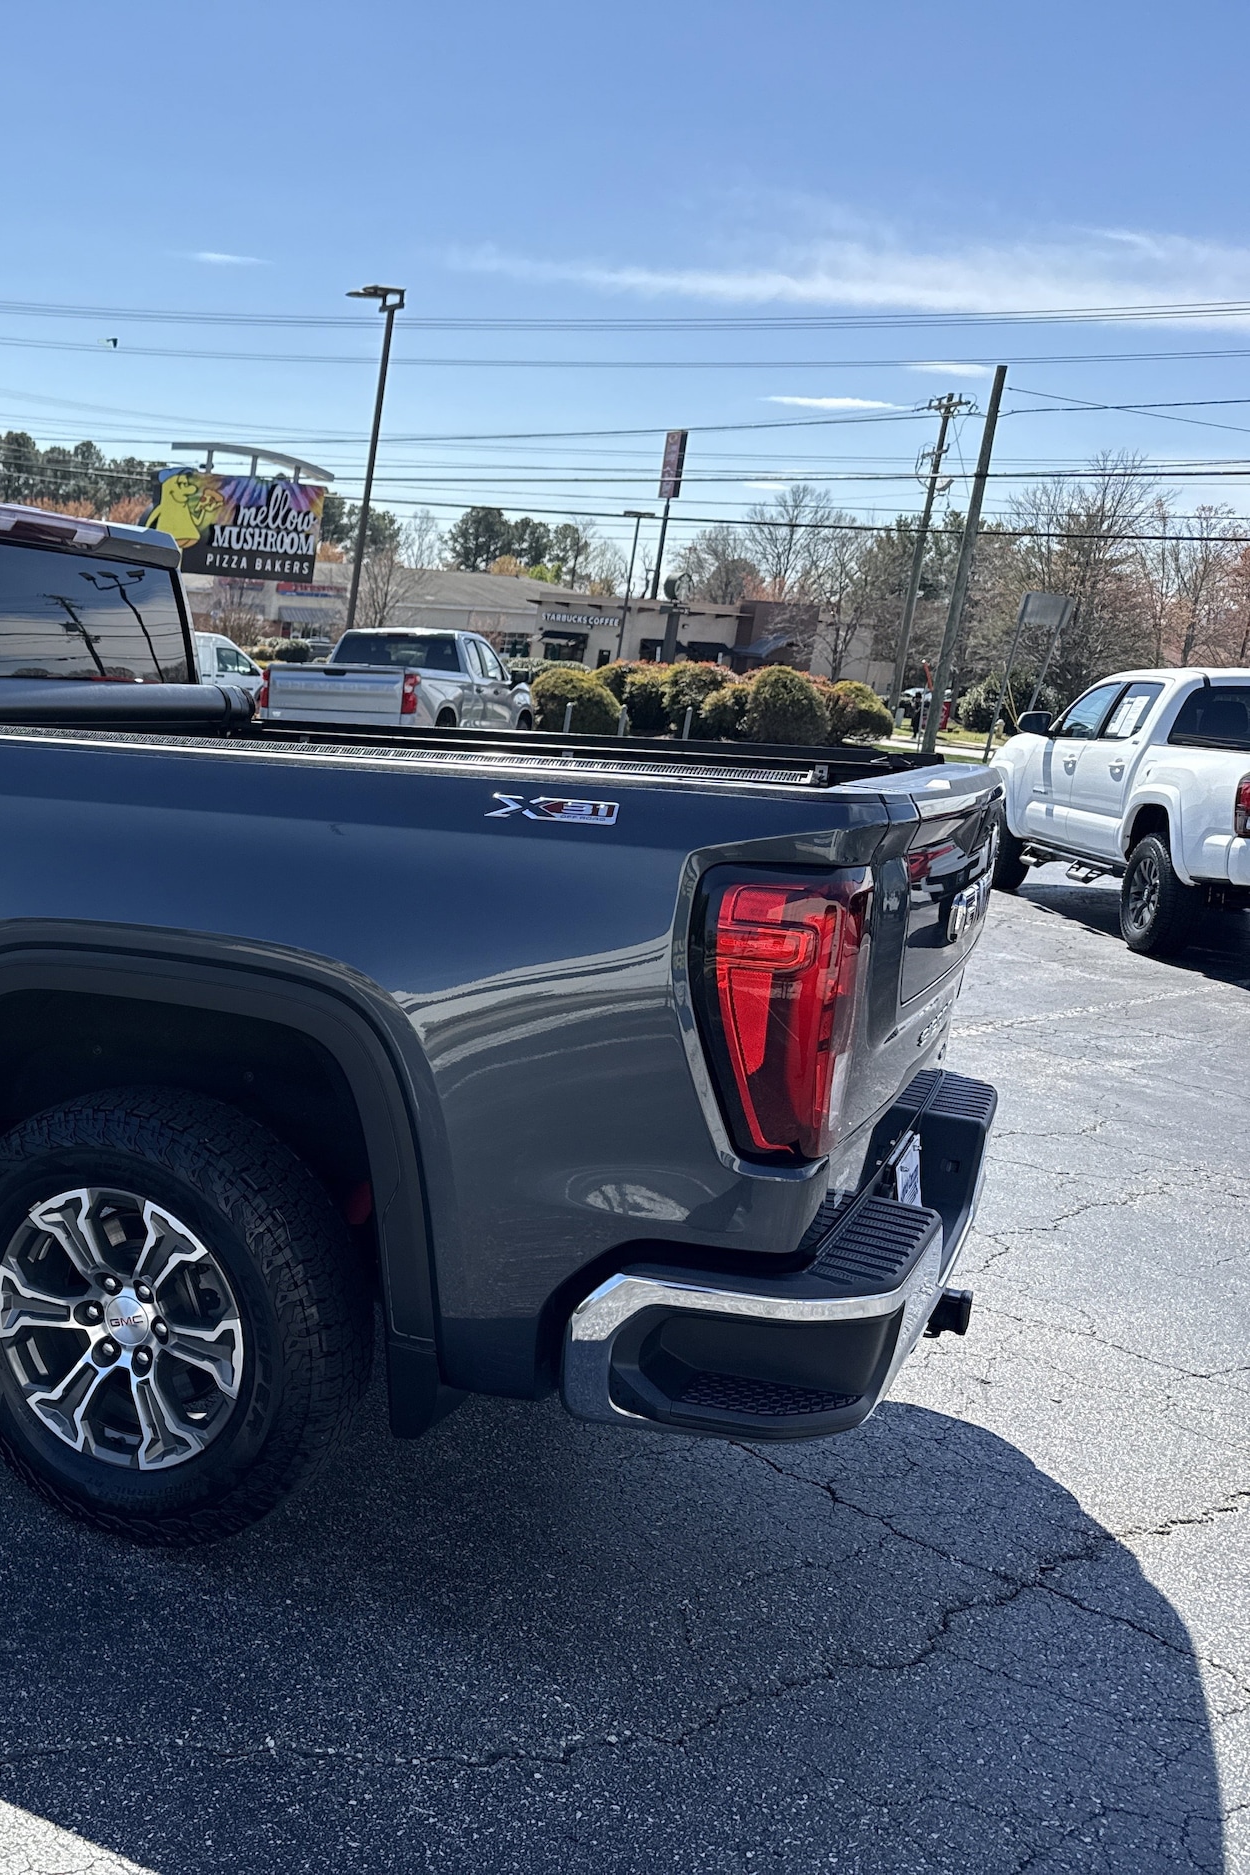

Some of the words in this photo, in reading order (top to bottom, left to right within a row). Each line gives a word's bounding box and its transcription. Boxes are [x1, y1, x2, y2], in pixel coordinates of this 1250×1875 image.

[237, 484, 318, 532] mellow
[212, 524, 315, 556] MUSHROOM
[206, 553, 248, 570] PIZZA
[254, 556, 310, 575] BAKERS
[541, 612, 587, 624] STARBUCKS
[588, 616, 620, 627] COFFEE
[484, 792, 612, 820] X31
[110, 1314, 144, 1328] GMC
